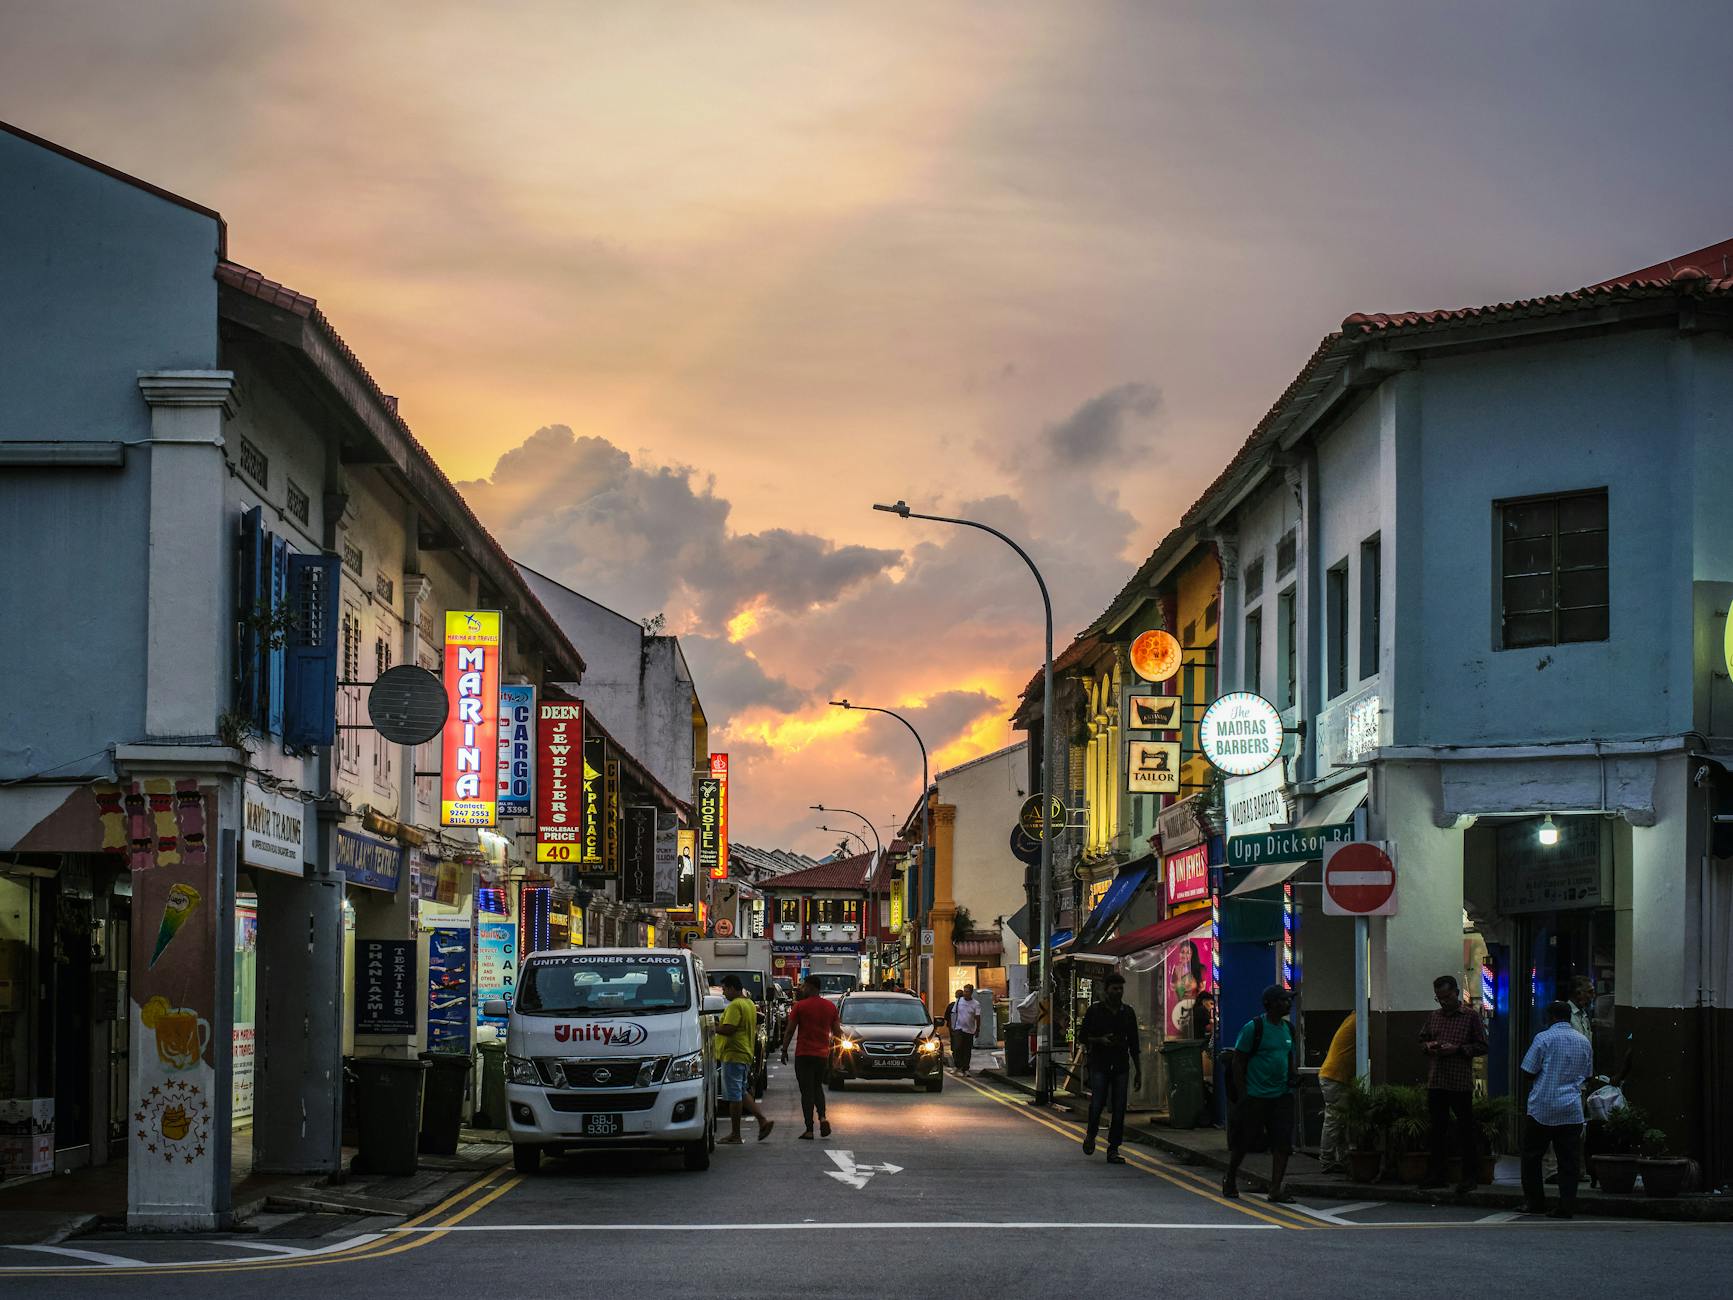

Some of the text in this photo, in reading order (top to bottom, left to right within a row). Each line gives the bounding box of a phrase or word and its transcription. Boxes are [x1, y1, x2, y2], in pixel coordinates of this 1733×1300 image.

[456, 646, 485, 800] MARINA
[541, 706, 579, 720] DEEN
[1231, 706, 1250, 719] The
[1217, 720, 1266, 736] MADRAS
[513, 706, 529, 796] CARGO
[1216, 738, 1269, 756] BARBERS
[549, 722, 571, 823] JEWELLERS
[1134, 772, 1175, 782] TAILOR
[1231, 797, 1254, 827] MADRAS
[1254, 788, 1280, 820] BARBERS
[586, 792, 597, 857] PALACE
[701, 798, 716, 848] HOSTEL
[544, 832, 575, 841] PRICE
[1235, 839, 1260, 862] Upp
[1267, 833, 1326, 855] Dickson
[547, 846, 570, 860] 40
[1176, 850, 1204, 887] UNI JEWELS
[502, 944, 513, 1001] CARG
[533, 958, 568, 966] UNITY
[367, 943, 383, 1018] DHANLAXMI
[393, 947, 406, 1016] TEXTILES
[554, 1024, 614, 1046] Unity
[587, 1124, 618, 1134] 930P
[591, 1115, 613, 1125] GBJ
